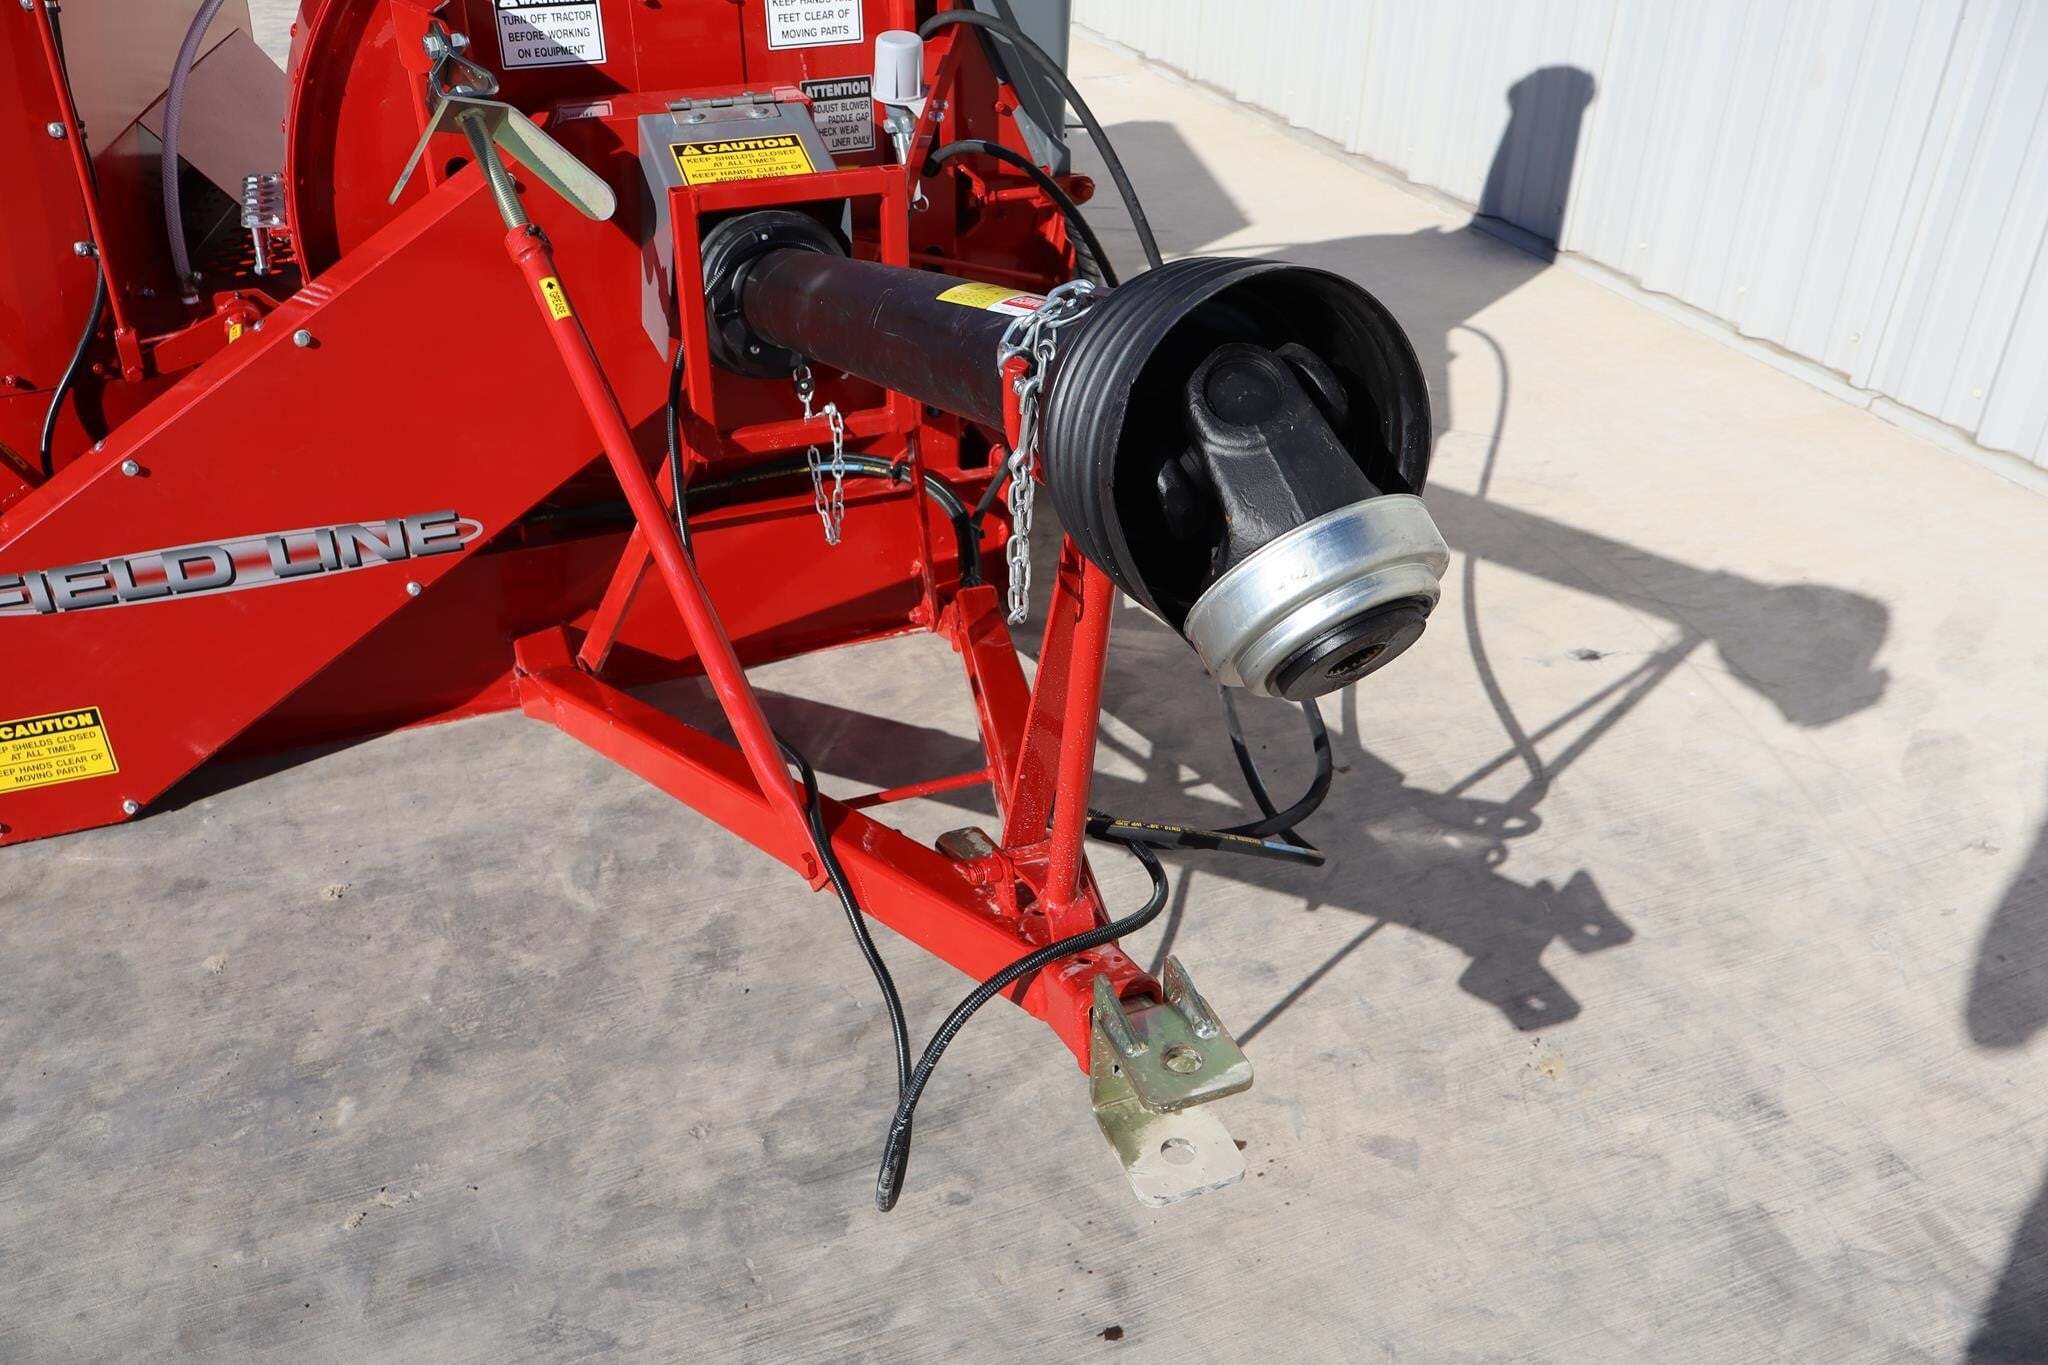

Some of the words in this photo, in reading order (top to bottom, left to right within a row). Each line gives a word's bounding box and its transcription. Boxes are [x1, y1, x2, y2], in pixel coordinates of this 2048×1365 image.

[502, 15, 527, 25] TURN
[530, 14, 547, 23] OFF
[551, 11, 592, 22] TRACTOR
[778, 13, 801, 22] FEET
[804, 10, 834, 20] CLEAR
[838, 9, 850, 18] OF
[508, 31, 545, 42] BEFORE
[548, 28, 591, 39] WORKING
[781, 28, 817, 39] MOVING
[821, 26, 849, 36] PARTS
[517, 48, 532, 58] ON
[535, 45, 585, 57] EQUIPMENT
[805, 81, 869, 98] ATTENTION
[840, 100, 869, 112] BLOWER
[828, 114, 853, 124] PADDLE
[855, 112, 869, 121] GAP
[817, 127, 837, 137] HECK
[840, 125, 859, 135] WEAR
[703, 137, 794, 153] CAUTION
[831, 137, 851, 147] LINER
[853, 135, 870, 145] DAILY
[715, 153, 755, 161] SHIELDS
[758, 149, 797, 157] CLOSED
[749, 157, 777, 165] TIMES
[721, 169, 754, 177] HANDS
[757, 166, 788, 174] CLEAR
[265, 509, 465, 578] LINE
[0, 713, 94, 739] CAUTION
[12, 738, 53, 752] SHIELDS
[56, 731, 96, 743] CLOSED
[11, 753, 21, 761] AT
[26, 750, 44, 759] ALL
[47, 743, 76, 755] TIMES
[19, 762, 53, 774] HANDS
[56, 755, 88, 766] CLEAR
[91, 753, 103, 761] OF
[15, 771, 53, 783] MOVING
[56, 765, 87, 776] PARTS
